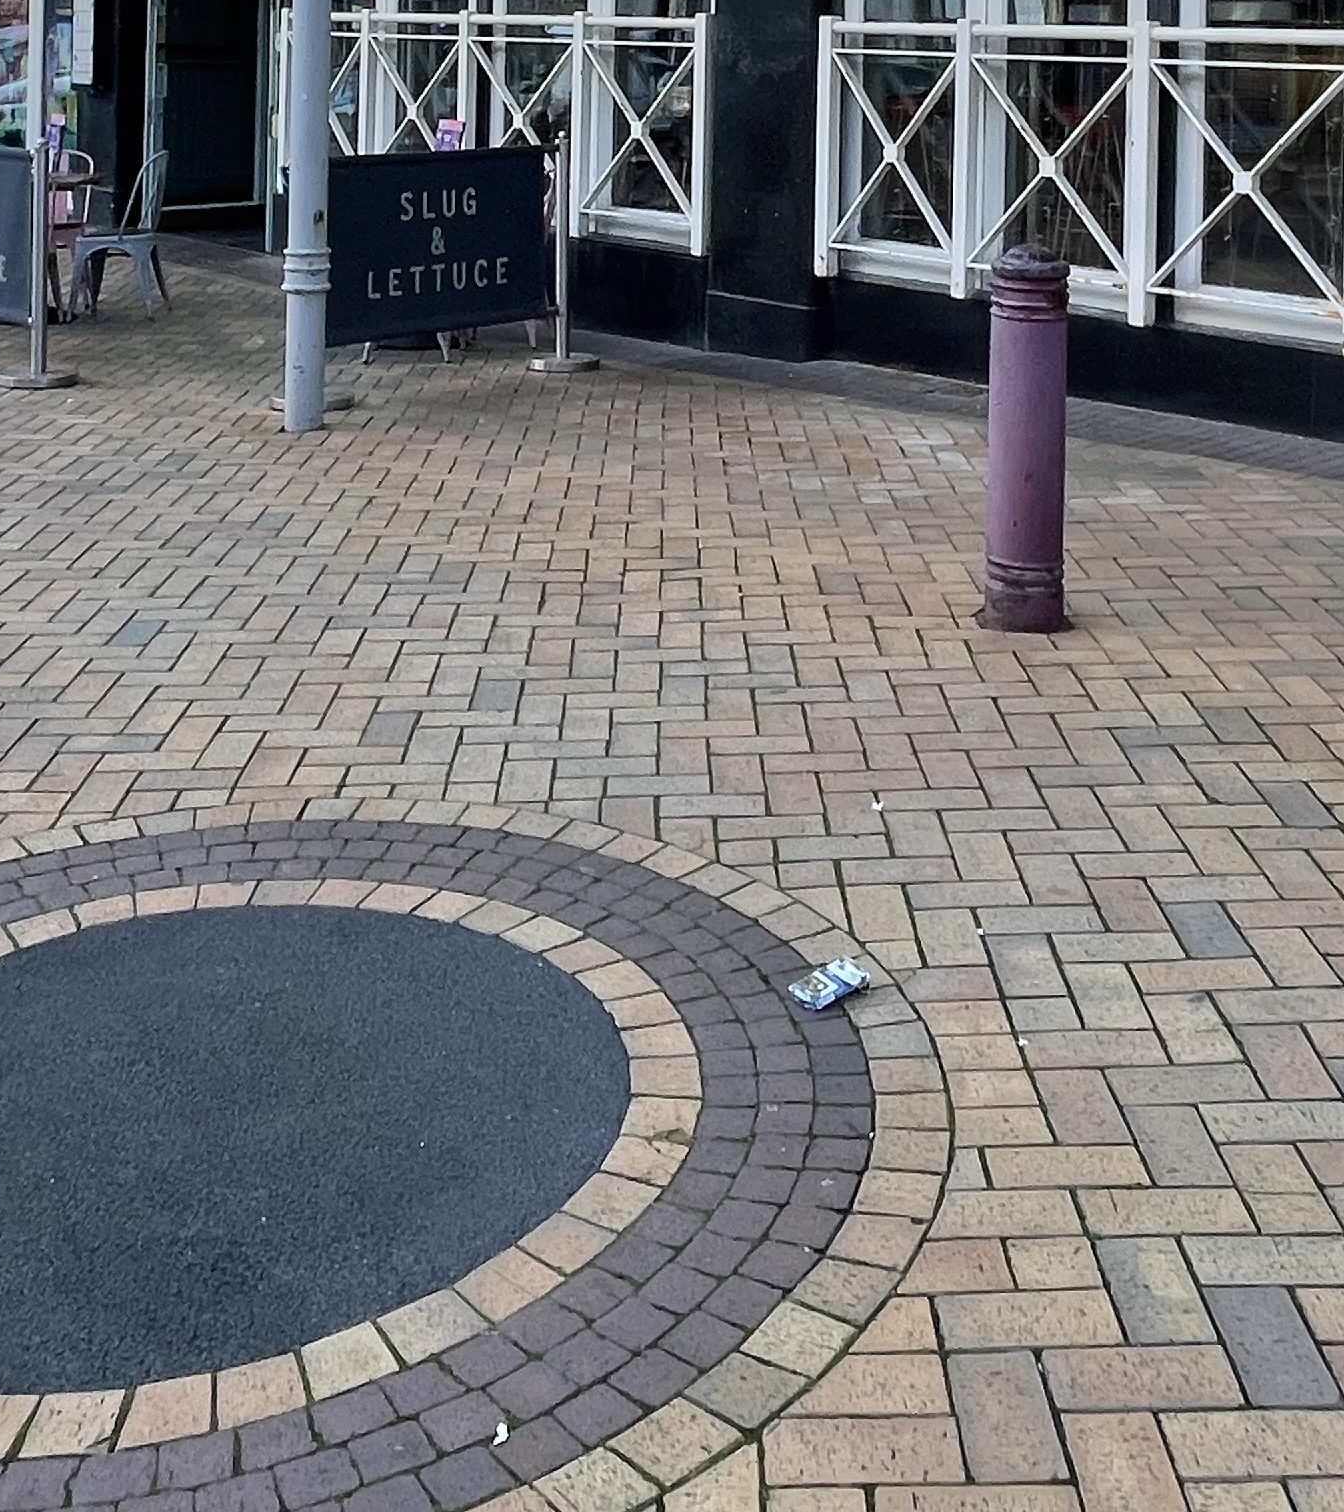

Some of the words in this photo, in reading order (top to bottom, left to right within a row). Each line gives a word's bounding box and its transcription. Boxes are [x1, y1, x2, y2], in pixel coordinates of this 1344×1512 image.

[400, 187, 477, 221] SLUG
[431, 226, 445, 255] &
[367, 257, 509, 299] LETTUCE
